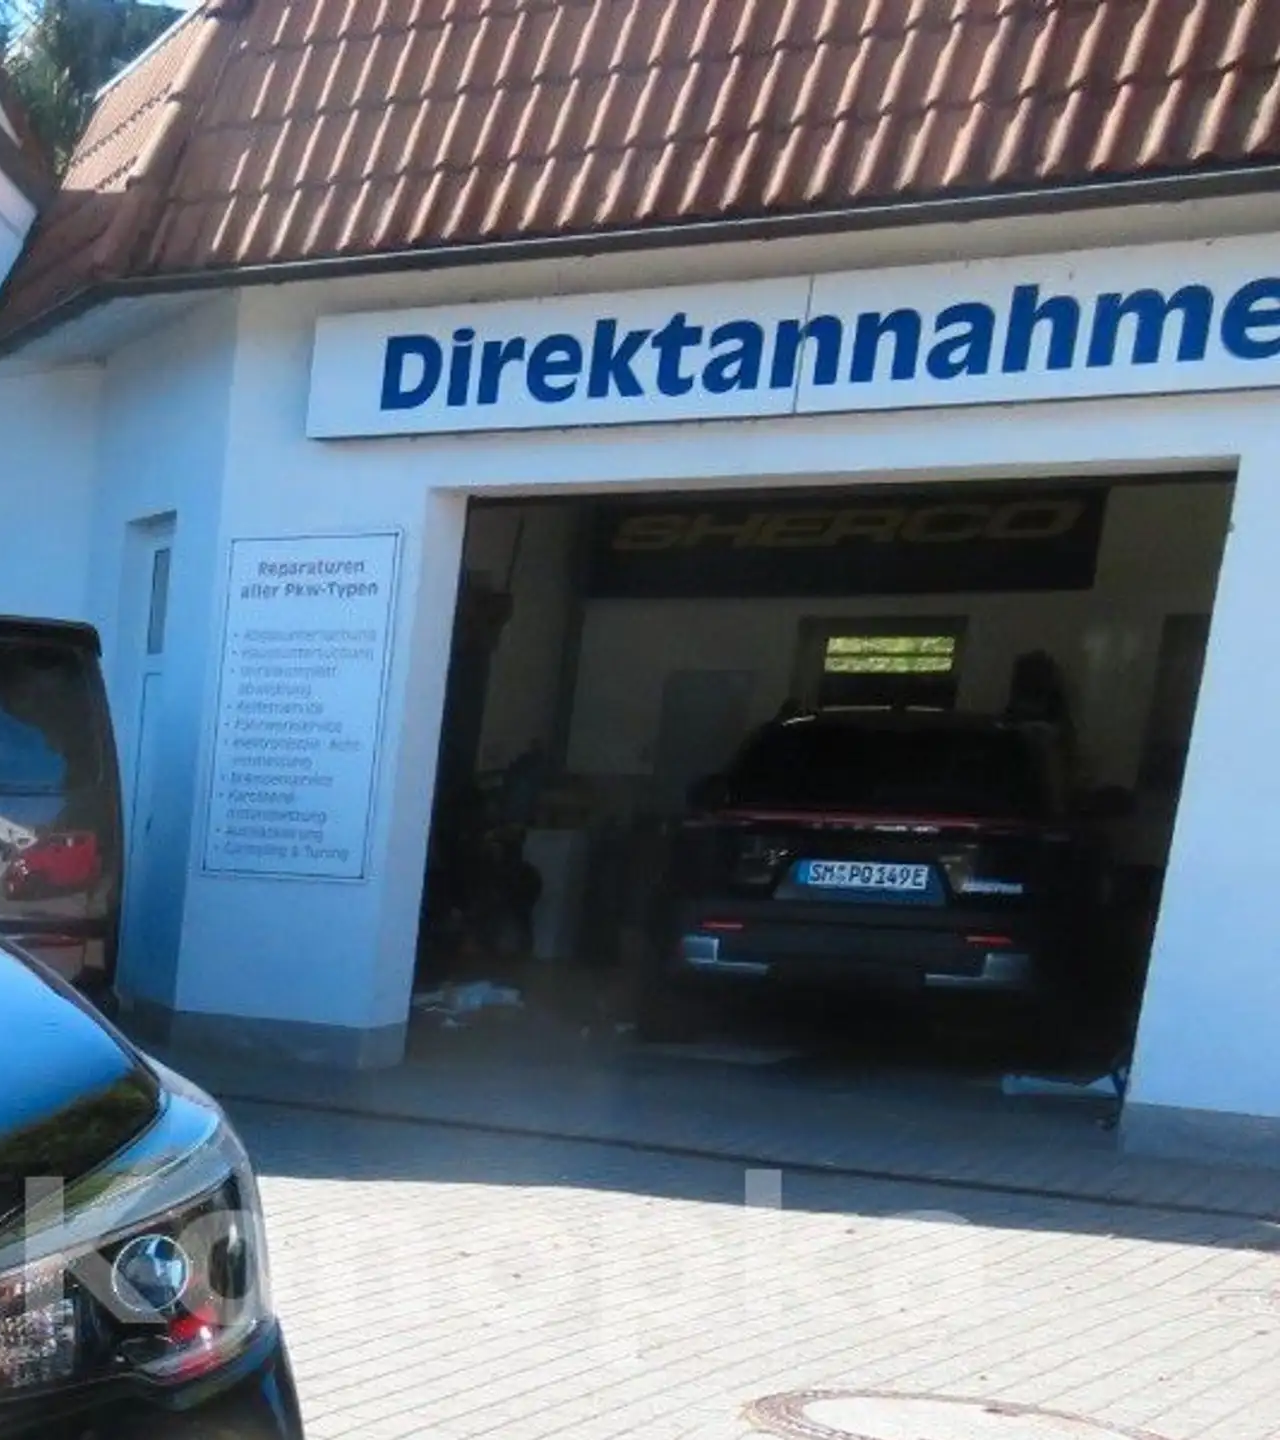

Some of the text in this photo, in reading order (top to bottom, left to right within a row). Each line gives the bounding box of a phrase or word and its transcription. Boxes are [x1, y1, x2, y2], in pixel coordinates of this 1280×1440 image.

[380, 274, 1280, 411] Direktannahme
[611, 500, 1087, 550] SHERCO
[258, 559, 365, 577] Reparaturen
[240, 581, 379, 599] aller Pkw-Typen
